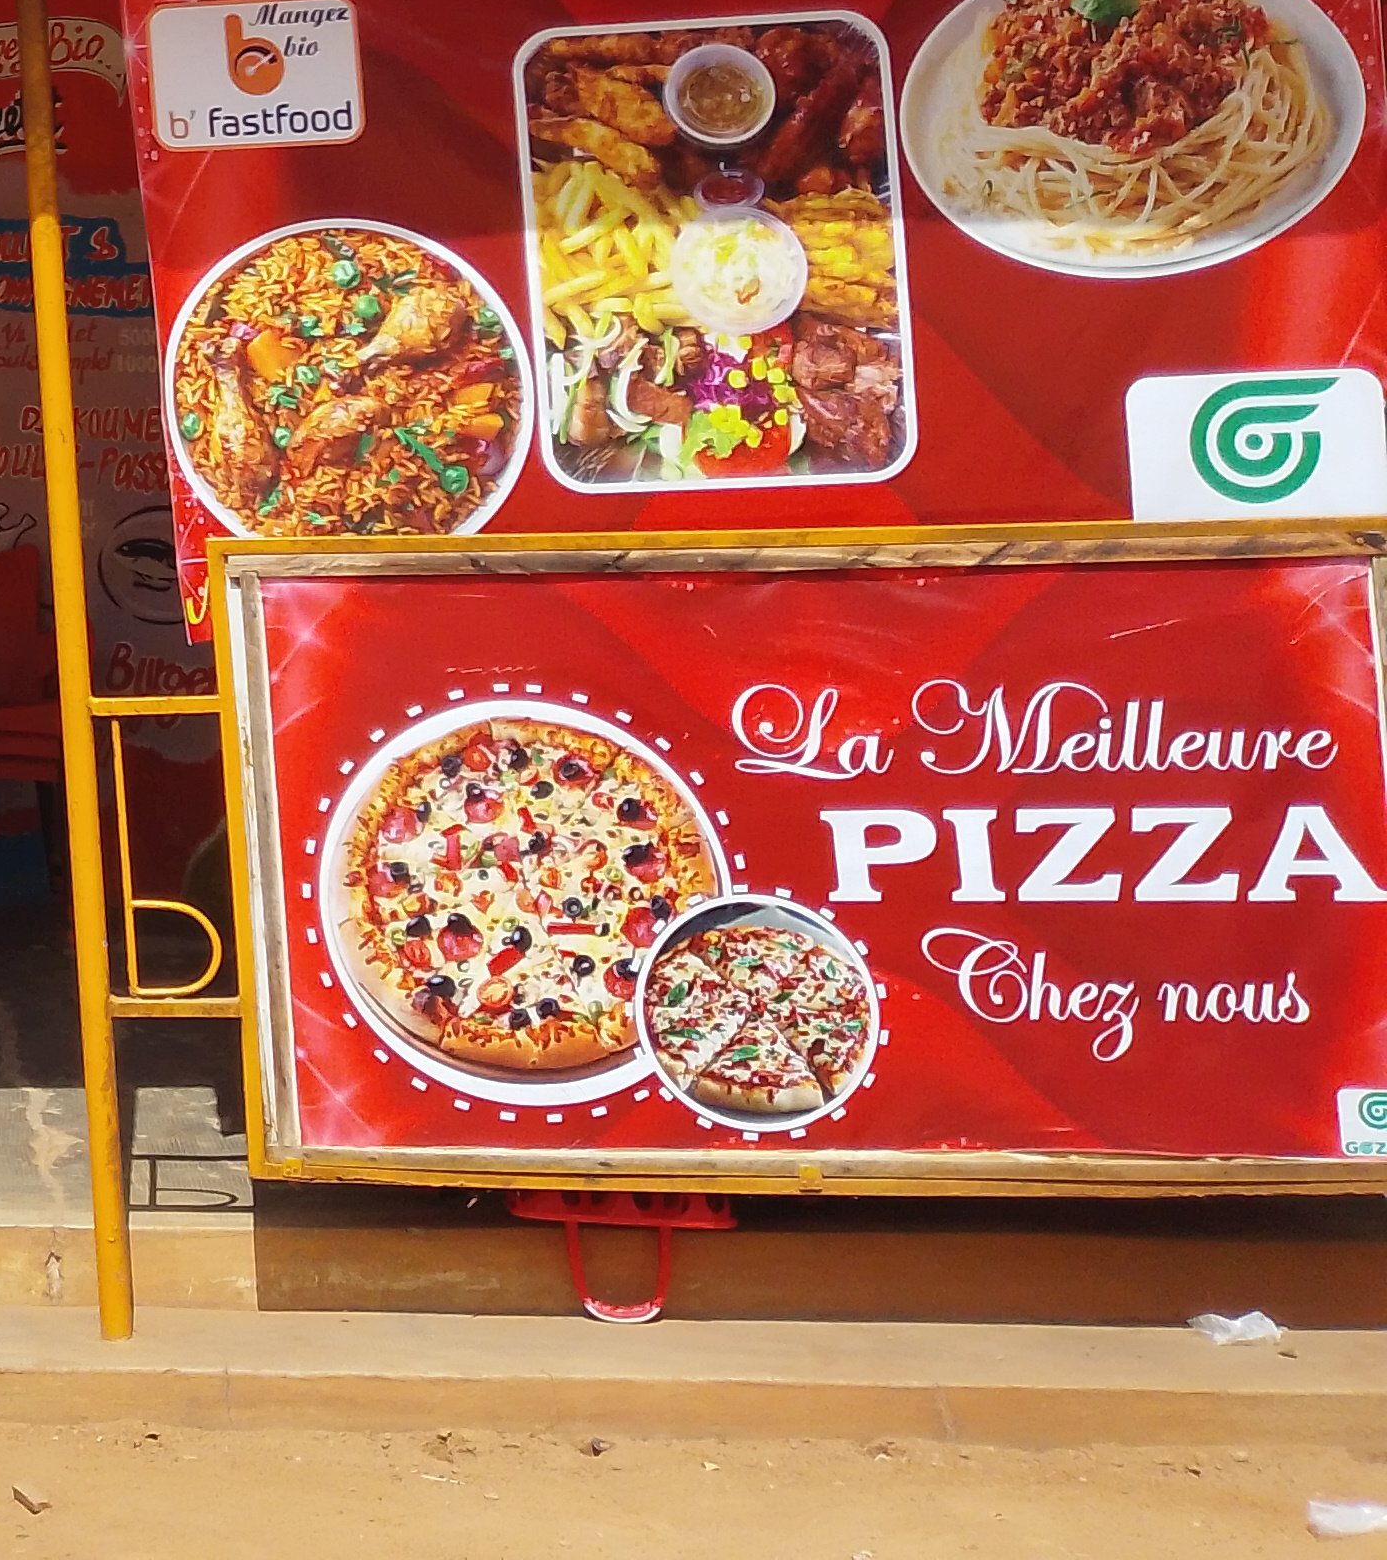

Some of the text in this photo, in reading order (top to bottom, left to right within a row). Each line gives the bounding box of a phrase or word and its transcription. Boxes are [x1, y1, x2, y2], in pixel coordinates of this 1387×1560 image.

[247, 3, 351, 28] Mangez
[282, 35, 320, 57] bio
[207, 100, 354, 138] fastfood
[729, 679, 1341, 782] La Meilleure
[819, 804, 1387, 904] PIZZA
[919, 926, 1311, 1062] Chez nous
